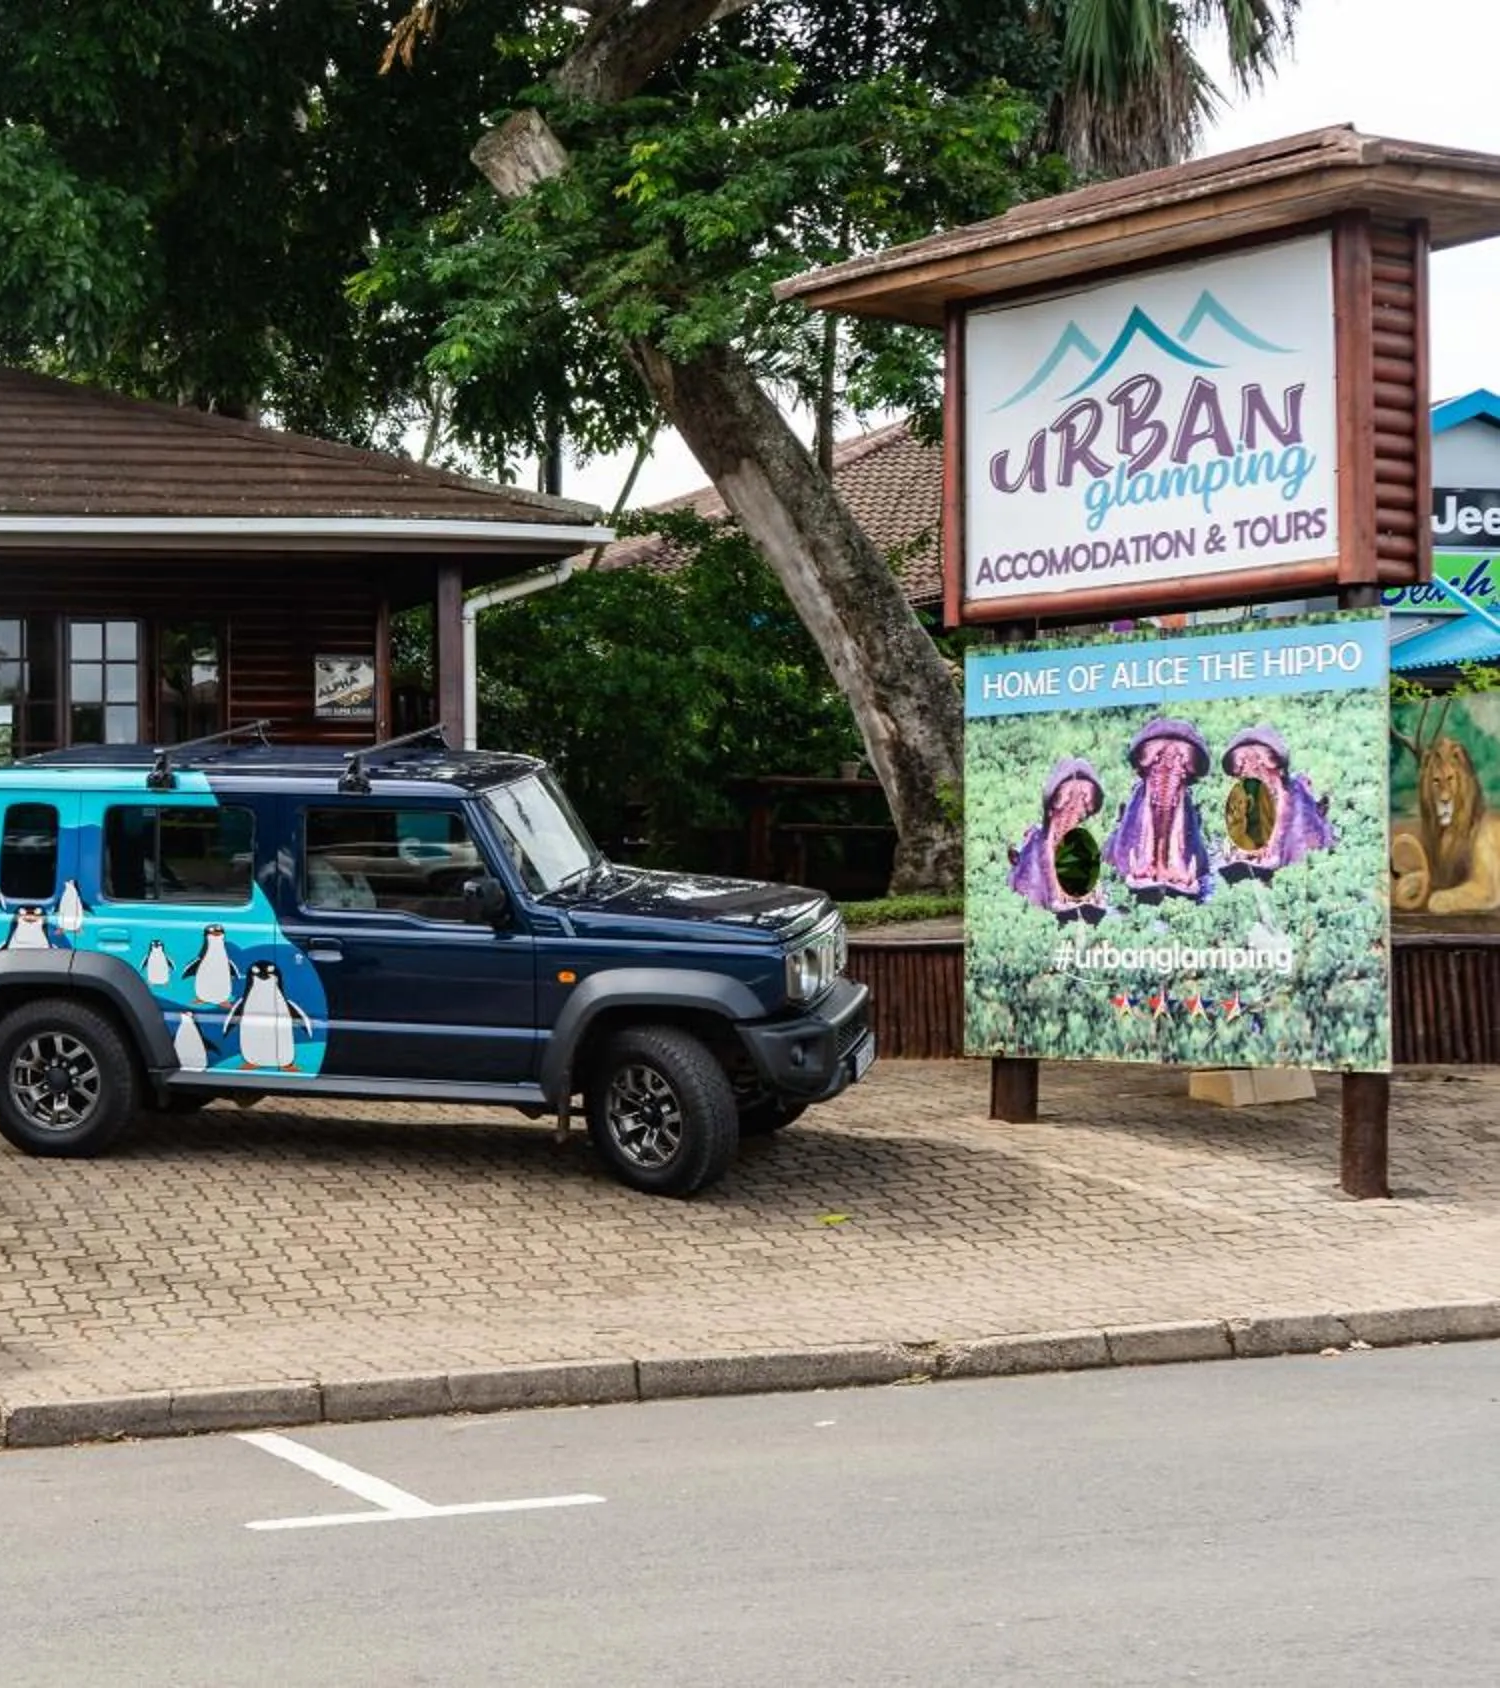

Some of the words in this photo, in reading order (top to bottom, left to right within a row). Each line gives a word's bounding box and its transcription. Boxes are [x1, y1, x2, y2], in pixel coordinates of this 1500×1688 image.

[989, 373, 1305, 494] URBAN
[1084, 443, 1317, 532] glamping
[975, 528, 1196, 586] ACCOMODATION
[1204, 523, 1226, 555] &
[1233, 507, 1328, 550] TOURS
[983, 668, 1061, 700] HOME
[1067, 664, 1105, 693] OF
[1111, 657, 1190, 690] ALICE
[1198, 651, 1256, 682] THE
[1263, 641, 1363, 678] HIPPO
[1054, 940, 1294, 974] #urbanglamping
